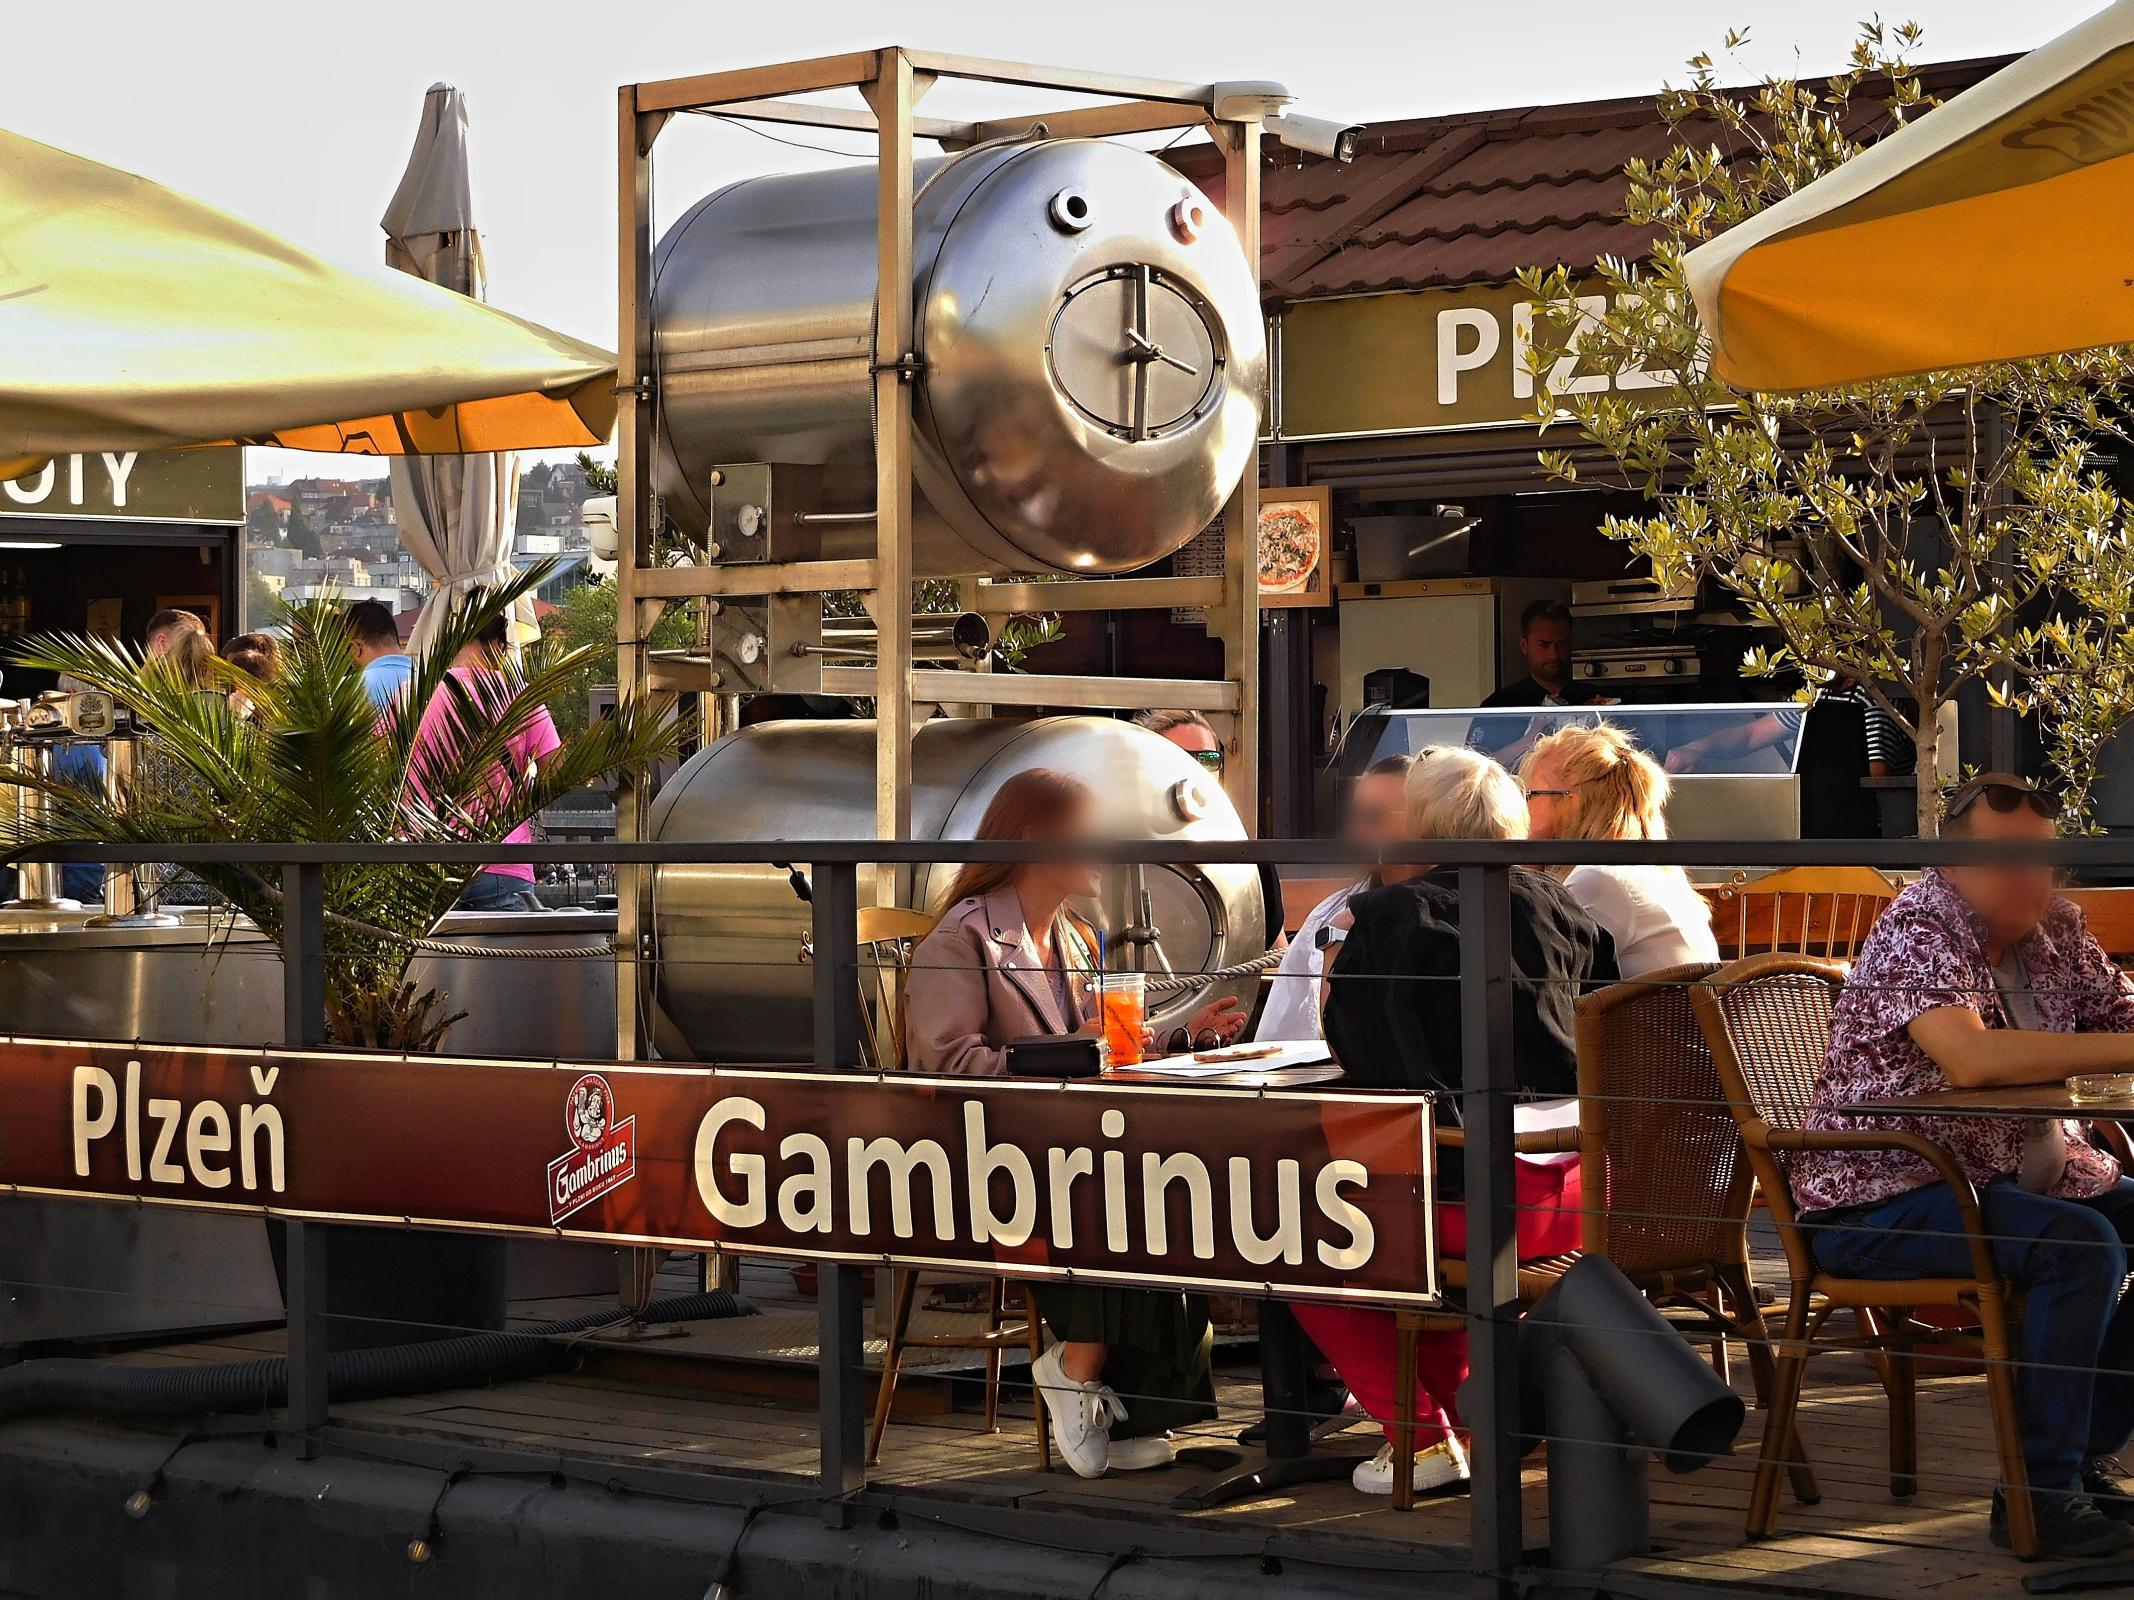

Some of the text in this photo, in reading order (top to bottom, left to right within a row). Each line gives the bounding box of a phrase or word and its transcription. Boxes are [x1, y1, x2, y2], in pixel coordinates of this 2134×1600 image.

[1437, 293, 1711, 405] PIZZ
[74, 1060, 285, 1192] Plzeň
[556, 1141, 627, 1205] Gambrinus
[694, 1096, 1375, 1270] Gambrinus
